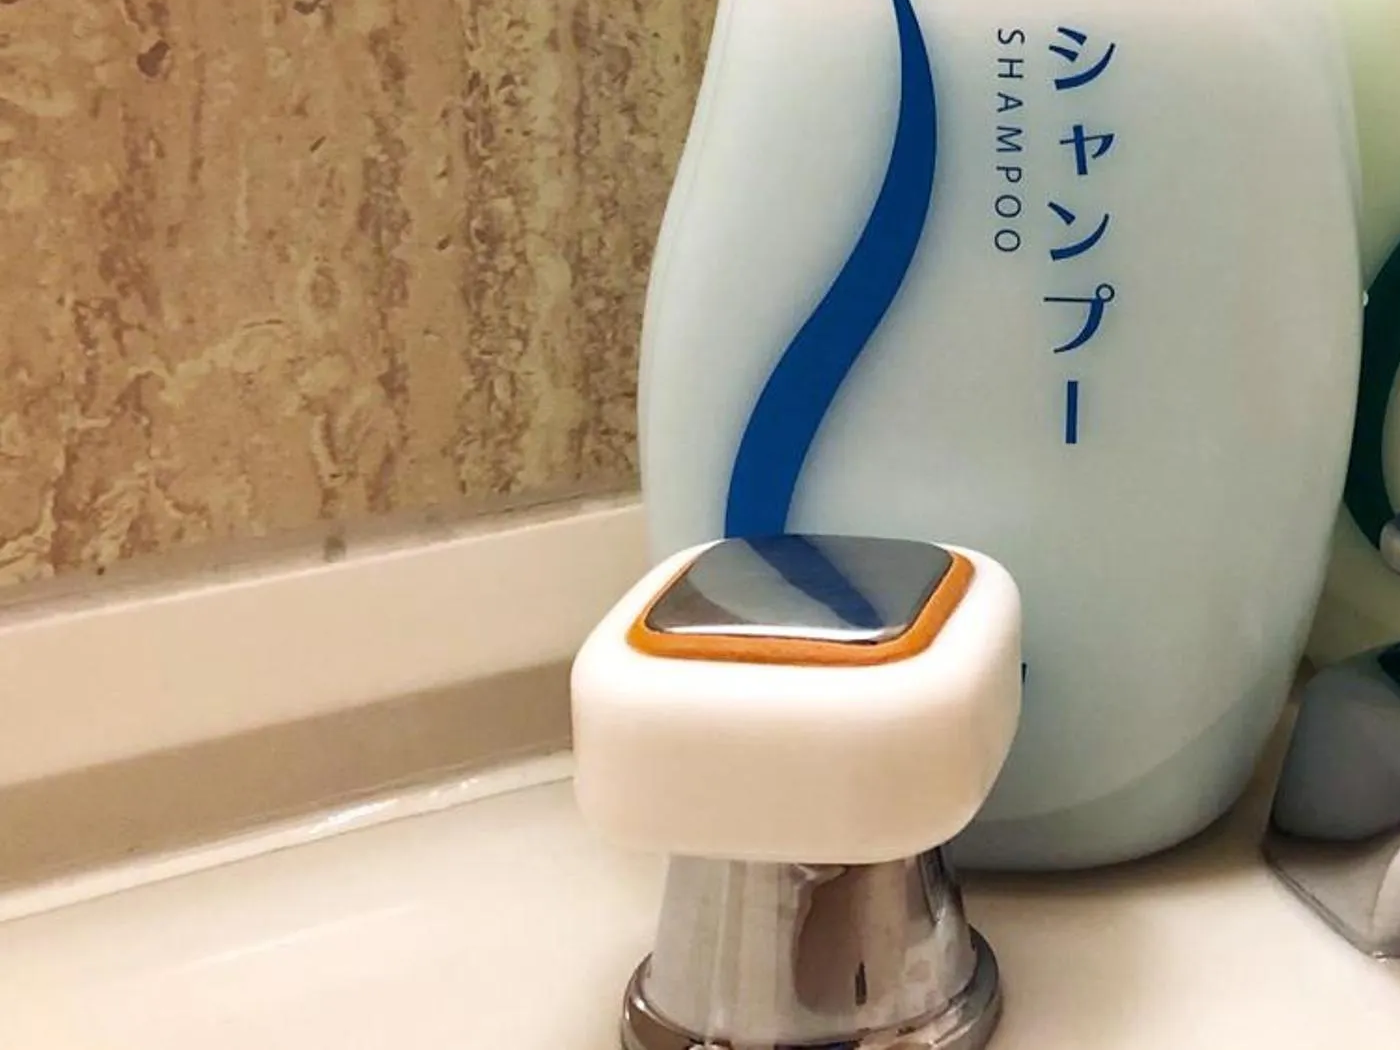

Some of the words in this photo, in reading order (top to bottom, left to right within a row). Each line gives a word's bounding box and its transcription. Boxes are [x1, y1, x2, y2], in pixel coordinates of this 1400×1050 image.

[993, 28, 1026, 254] SHAMPOO
[1042, 26, 1116, 445] シャンプー
